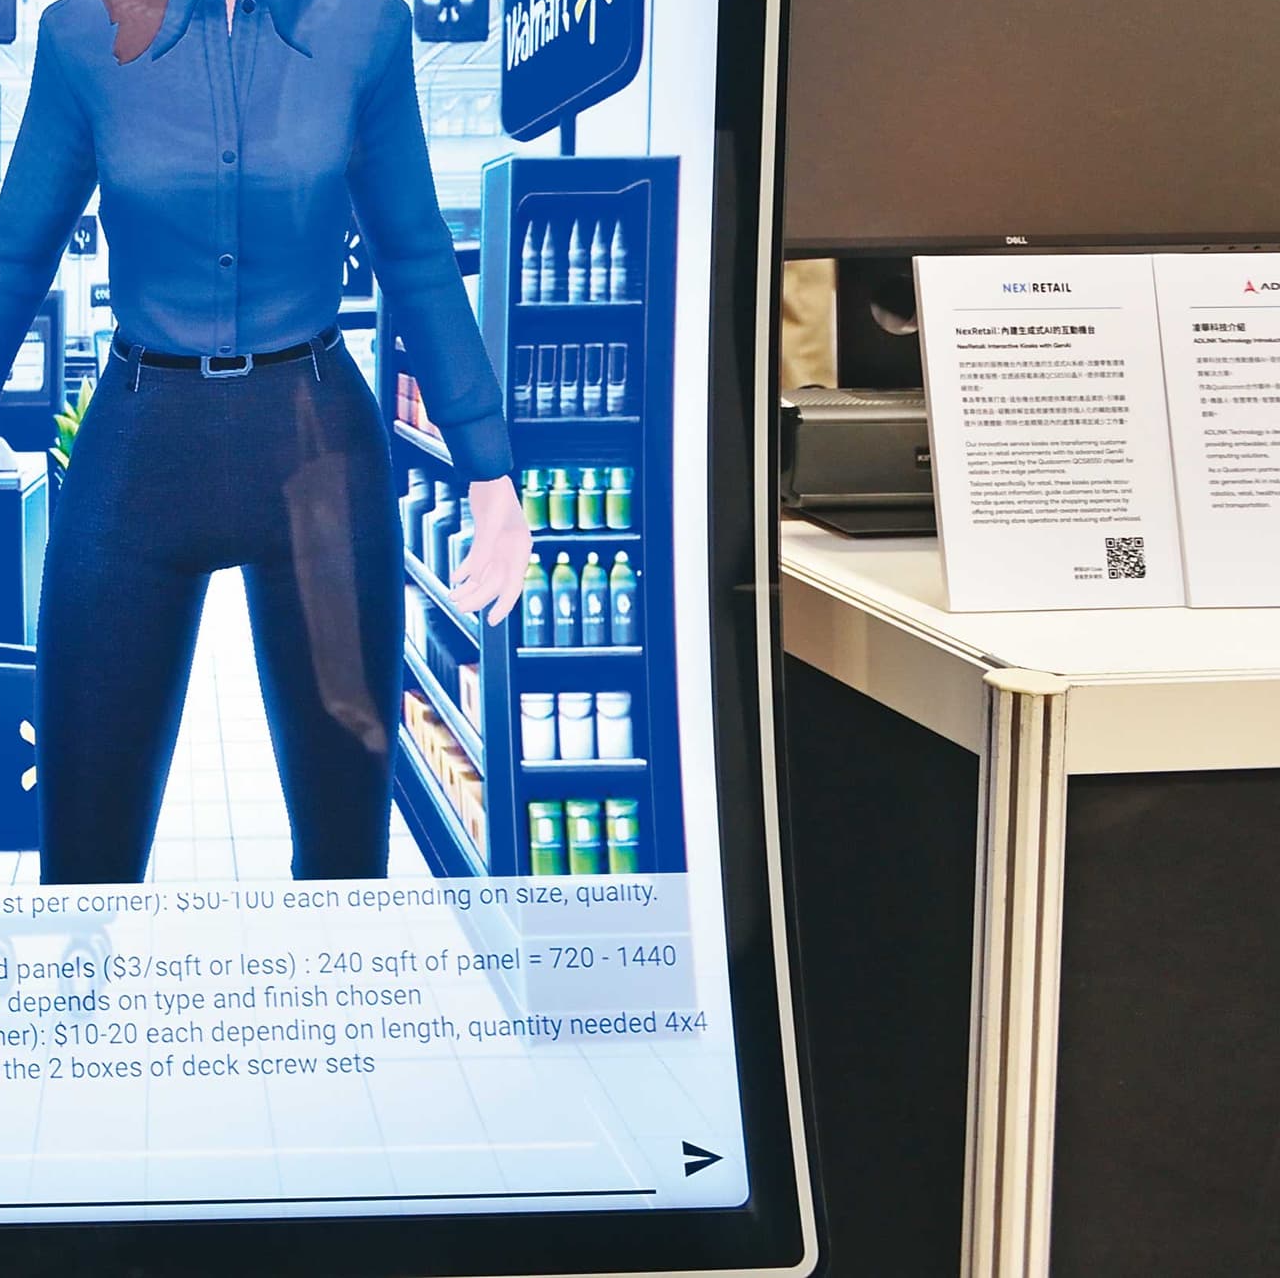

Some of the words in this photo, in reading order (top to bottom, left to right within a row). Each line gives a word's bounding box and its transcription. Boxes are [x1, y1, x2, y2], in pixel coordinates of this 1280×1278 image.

[1005, 236, 1028, 245] DELL
[31, 896, 70, 919] per
[76, 893, 168, 916] corner):
[176, 890, 274, 913] $50-100
[283, 889, 339, 909] each
[347, 888, 472, 912] depending
[479, 887, 509, 905] on
[515, 886, 569, 906] size,
[576, 883, 658, 908] quality.
[17, 955, 96, 985] panels
[103, 953, 202, 984] ($3/sqft
[209, 959, 233, 976] or
[240, 952, 296, 979] less)
[317, 951, 363, 974] 240
[371, 949, 418, 978] sqft
[425, 948, 449, 972] of
[457, 947, 520, 976] panel
[548, 946, 594, 969] 720
[617, 944, 677, 967] 1440
[7, 988, 111, 1018] depends
[118, 993, 147, 1011] on
[153, 990, 205, 1016] type
[213, 985, 256, 1009] and
[263, 985, 328, 1008] finish
[335, 984, 422, 1007] chosen
[54, 1020, 138, 1048] $10-20
[146, 1020, 203, 1044] each
[211, 1018, 336, 1047] depending
[344, 1022, 374, 1040] on
[381, 1015, 460, 1044] length,
[468, 1013, 563, 1043] quantity
[569, 1010, 657, 1035] needed
[664, 1010, 708, 1033] 4x4
[1, 1057, 41, 1080] the
[48, 1057, 64, 1079] 2
[71, 1056, 143, 1079] boxes
[150, 1053, 174, 1078] of
[182, 1053, 240, 1077] deck
[247, 1057, 318, 1075] screw
[325, 1053, 376, 1074] sets
